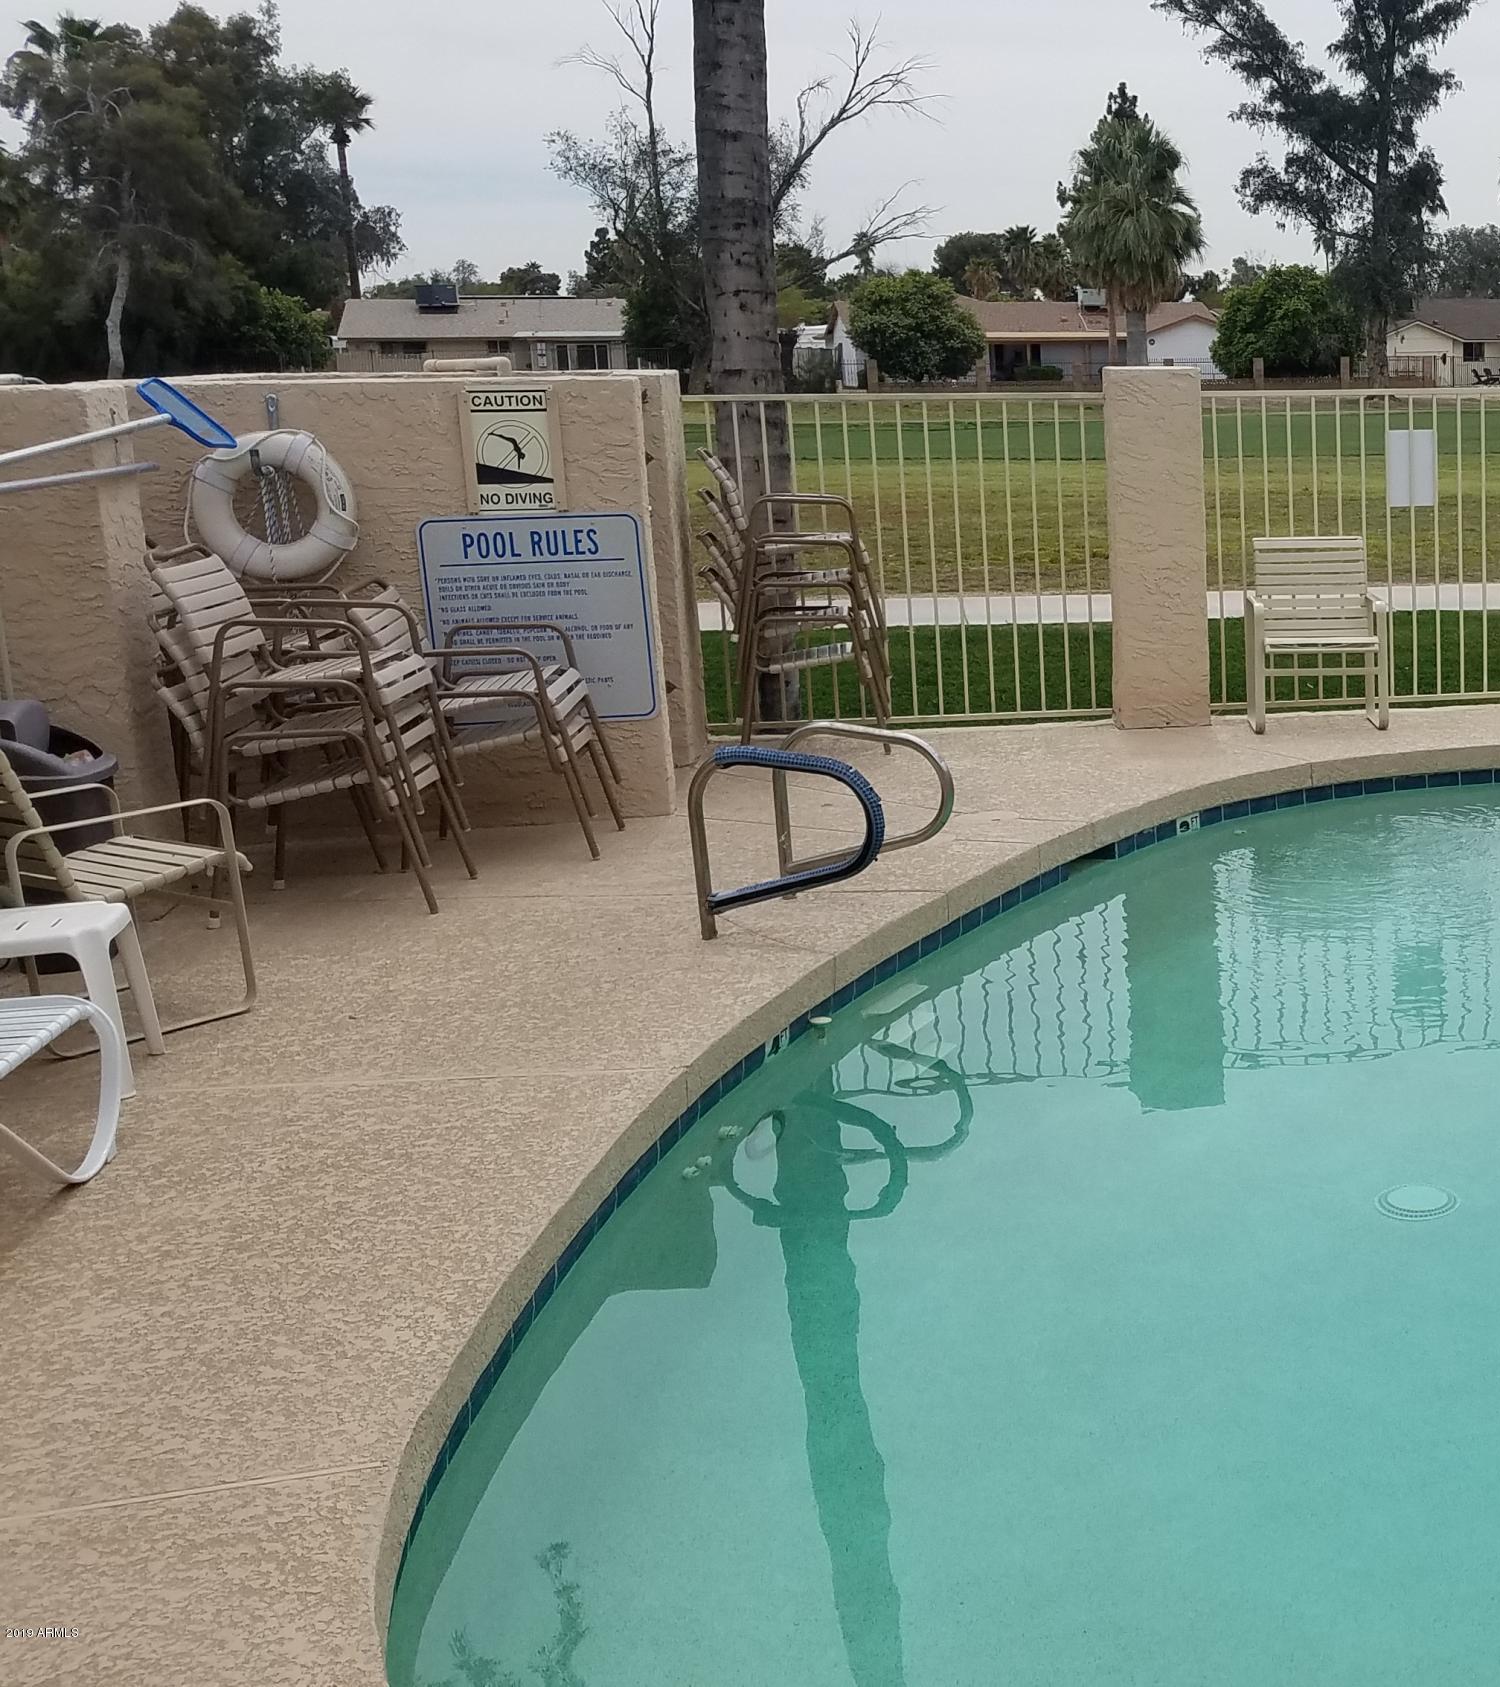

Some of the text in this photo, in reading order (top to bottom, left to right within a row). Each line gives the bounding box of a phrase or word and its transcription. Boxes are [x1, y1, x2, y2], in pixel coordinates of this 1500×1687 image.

[471, 395, 543, 407] CAUTION
[480, 492, 553, 505] NO DIVING
[461, 528, 600, 560] POOL RULES
[463, 575, 476, 583] WITH
[477, 575, 490, 583] SORE
[501, 574, 526, 583] INFLAMED
[438, 585, 454, 593] BOILS
[464, 584, 481, 592] OTHER
[482, 583, 498, 591] ACUTE
[509, 582, 531, 590] OBVIOUS
[439, 592, 470, 601] INFECTIONS
[471, 592, 478, 600] OR
[480, 592, 493, 600] CUTS
[494, 591, 511, 599] SHALL
[520, 590, 546, 598] EXCLUDED
[547, 589, 562, 597] FROM
[451, 617, 475, 625] ANIMALS
[476, 616, 500, 624] ALLOWED
[501, 615, 519, 623] EXCEPT
[532, 614, 554, 622] SERVICE
[599, 624, 613, 632] FOOD
[459, 637, 476, 646] SHALL
[477, 637, 484, 645] BE
[485, 636, 512, 645] PERMITTED
